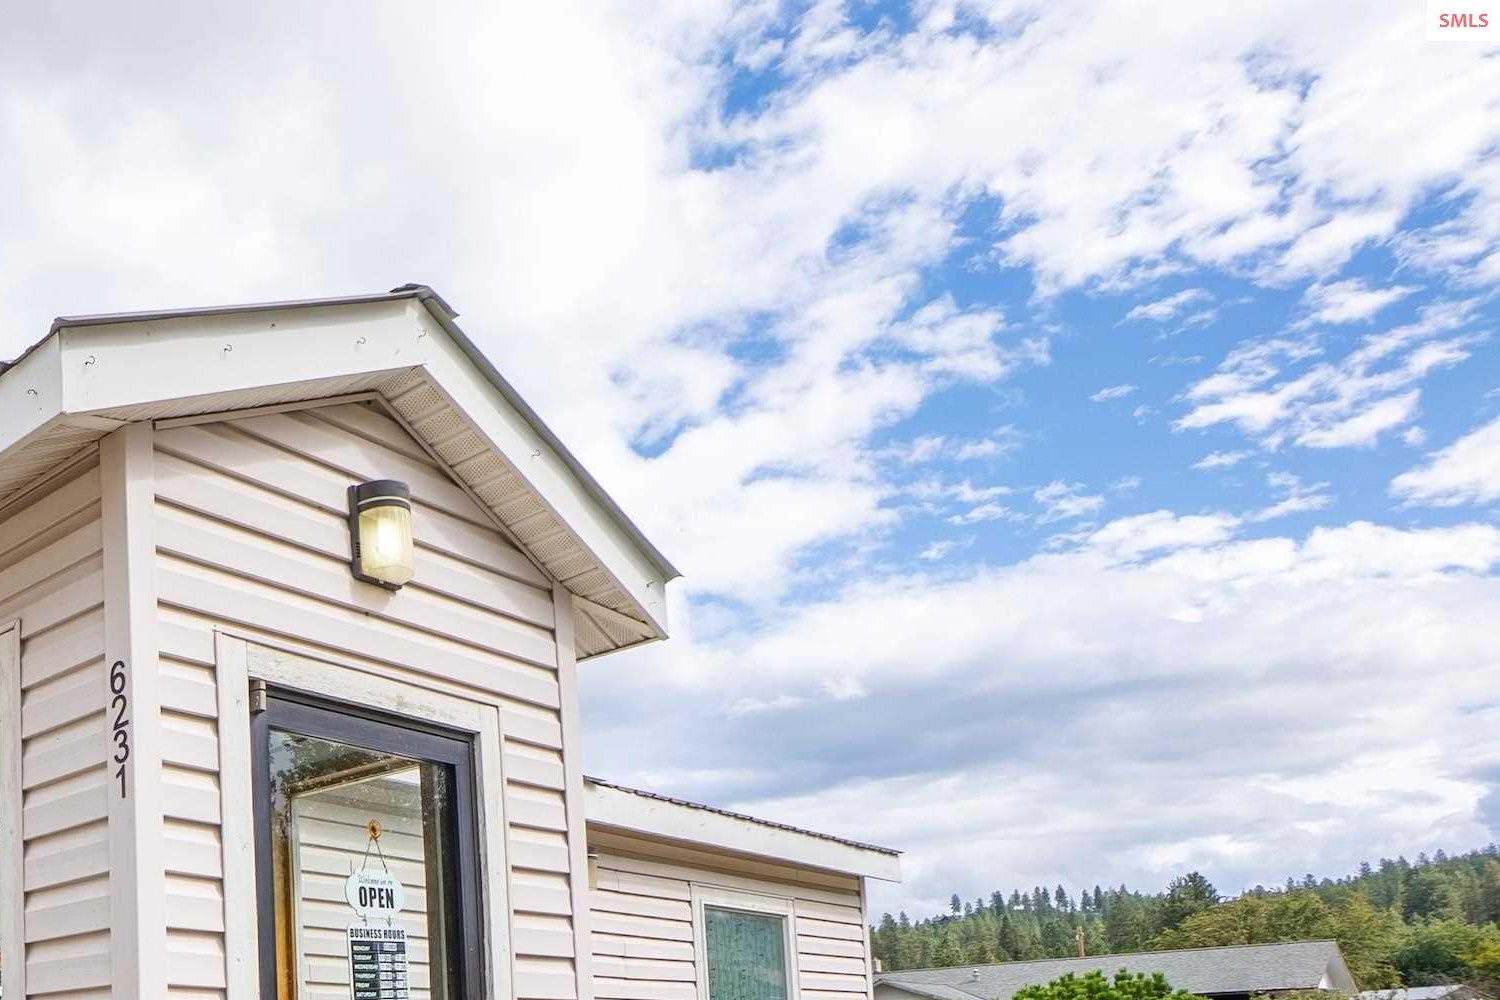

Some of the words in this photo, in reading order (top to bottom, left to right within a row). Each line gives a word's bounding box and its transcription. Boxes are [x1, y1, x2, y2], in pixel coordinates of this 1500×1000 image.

[109, 659, 130, 799] 6231
[359, 886, 394, 909] OPEN
[350, 928, 382, 939] BUSINESS
[383, 929, 405, 940] HOURS
